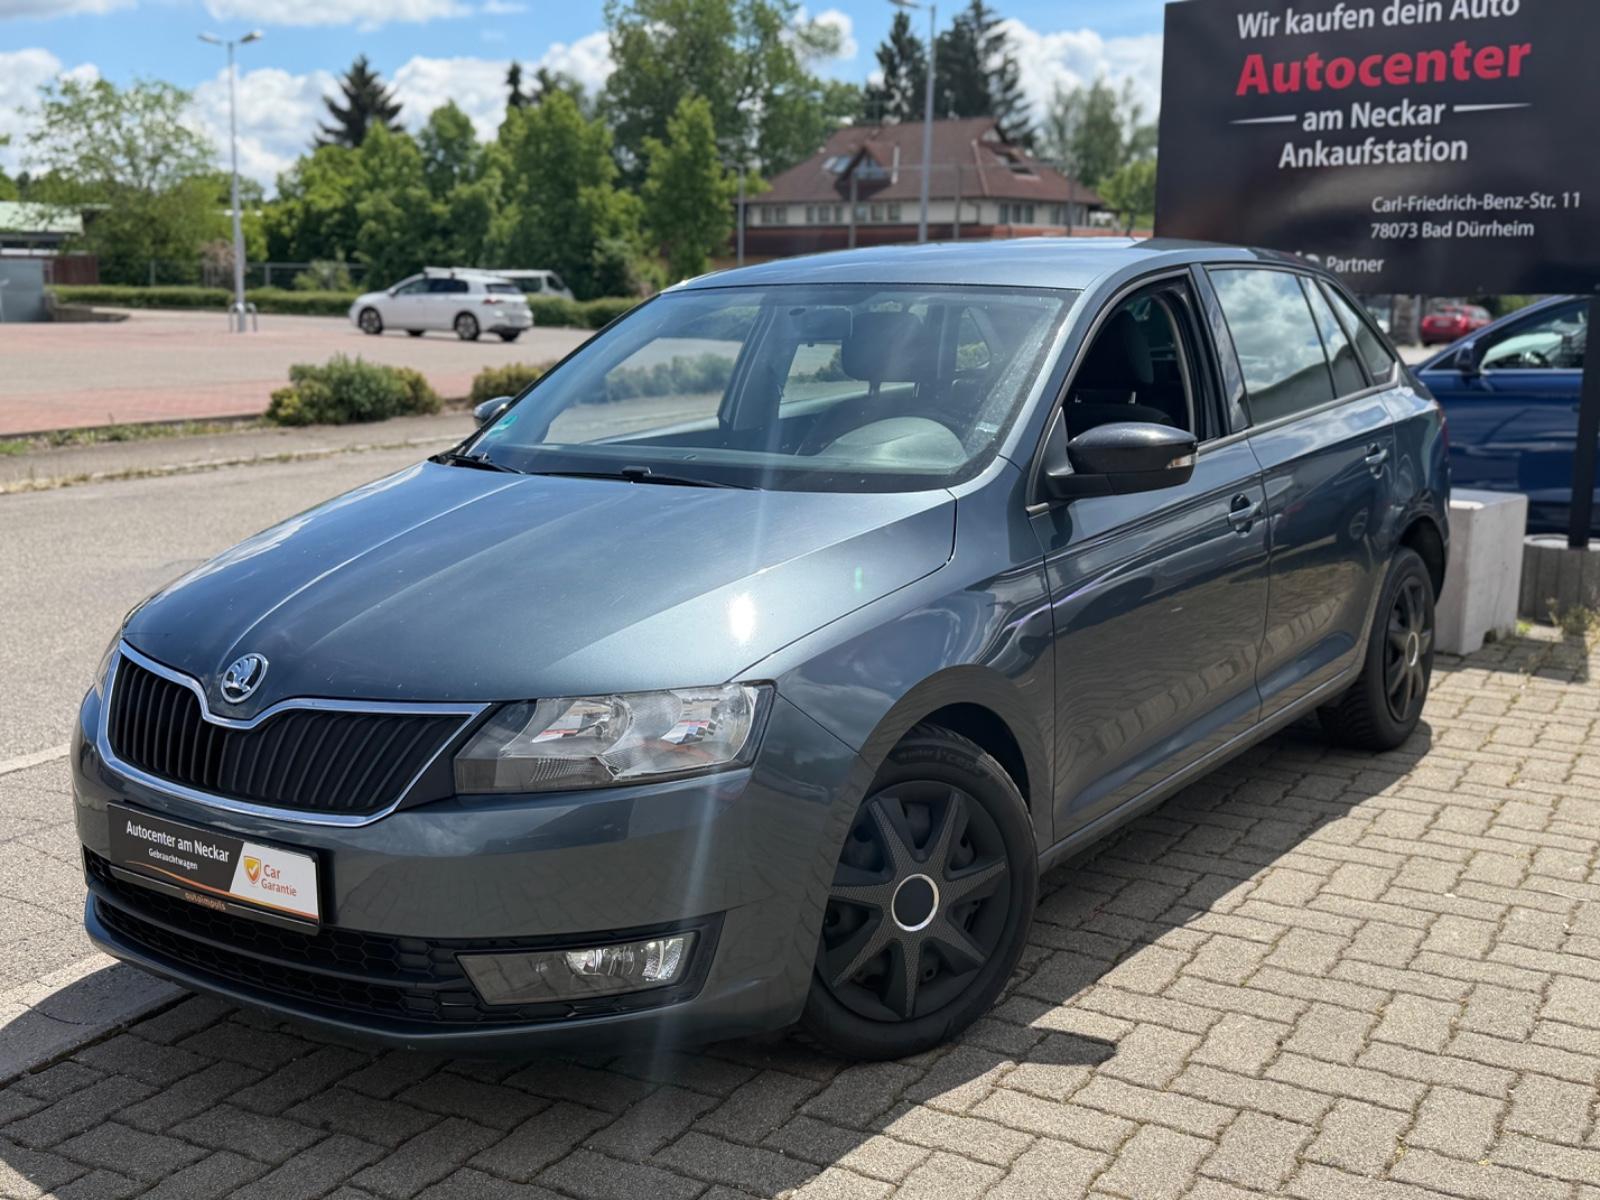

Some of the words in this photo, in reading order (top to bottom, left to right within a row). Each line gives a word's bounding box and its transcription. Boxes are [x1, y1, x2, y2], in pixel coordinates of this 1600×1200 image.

[1237, 11, 1280, 39] Wir
[1285, 2, 1375, 35] kaufen
[1382, 0, 1443, 26] dein
[1449, 0, 1520, 20] Auto
[1236, 40, 1533, 96] Autocenter
[1302, 110, 1344, 132] am
[1350, 98, 1447, 129] Neckar
[1278, 135, 1469, 169] Ankaufstation
[1371, 192, 1557, 213] Carl-Friedrich-Benz-Str.
[1561, 191, 1581, 208] 11
[1370, 222, 1418, 239] 78073
[1421, 221, 1453, 238] Bad
[1455, 220, 1535, 238] Dürrheim
[1326, 255, 1384, 273] Partner
[126, 820, 176, 848] Autocenter
[177, 838, 193, 853] am
[194, 839, 230, 863] Neckar
[148, 848, 198, 871] Gebrauchtwagen
[263, 864, 281, 880] Car
[261, 878, 297, 897] Garantie
